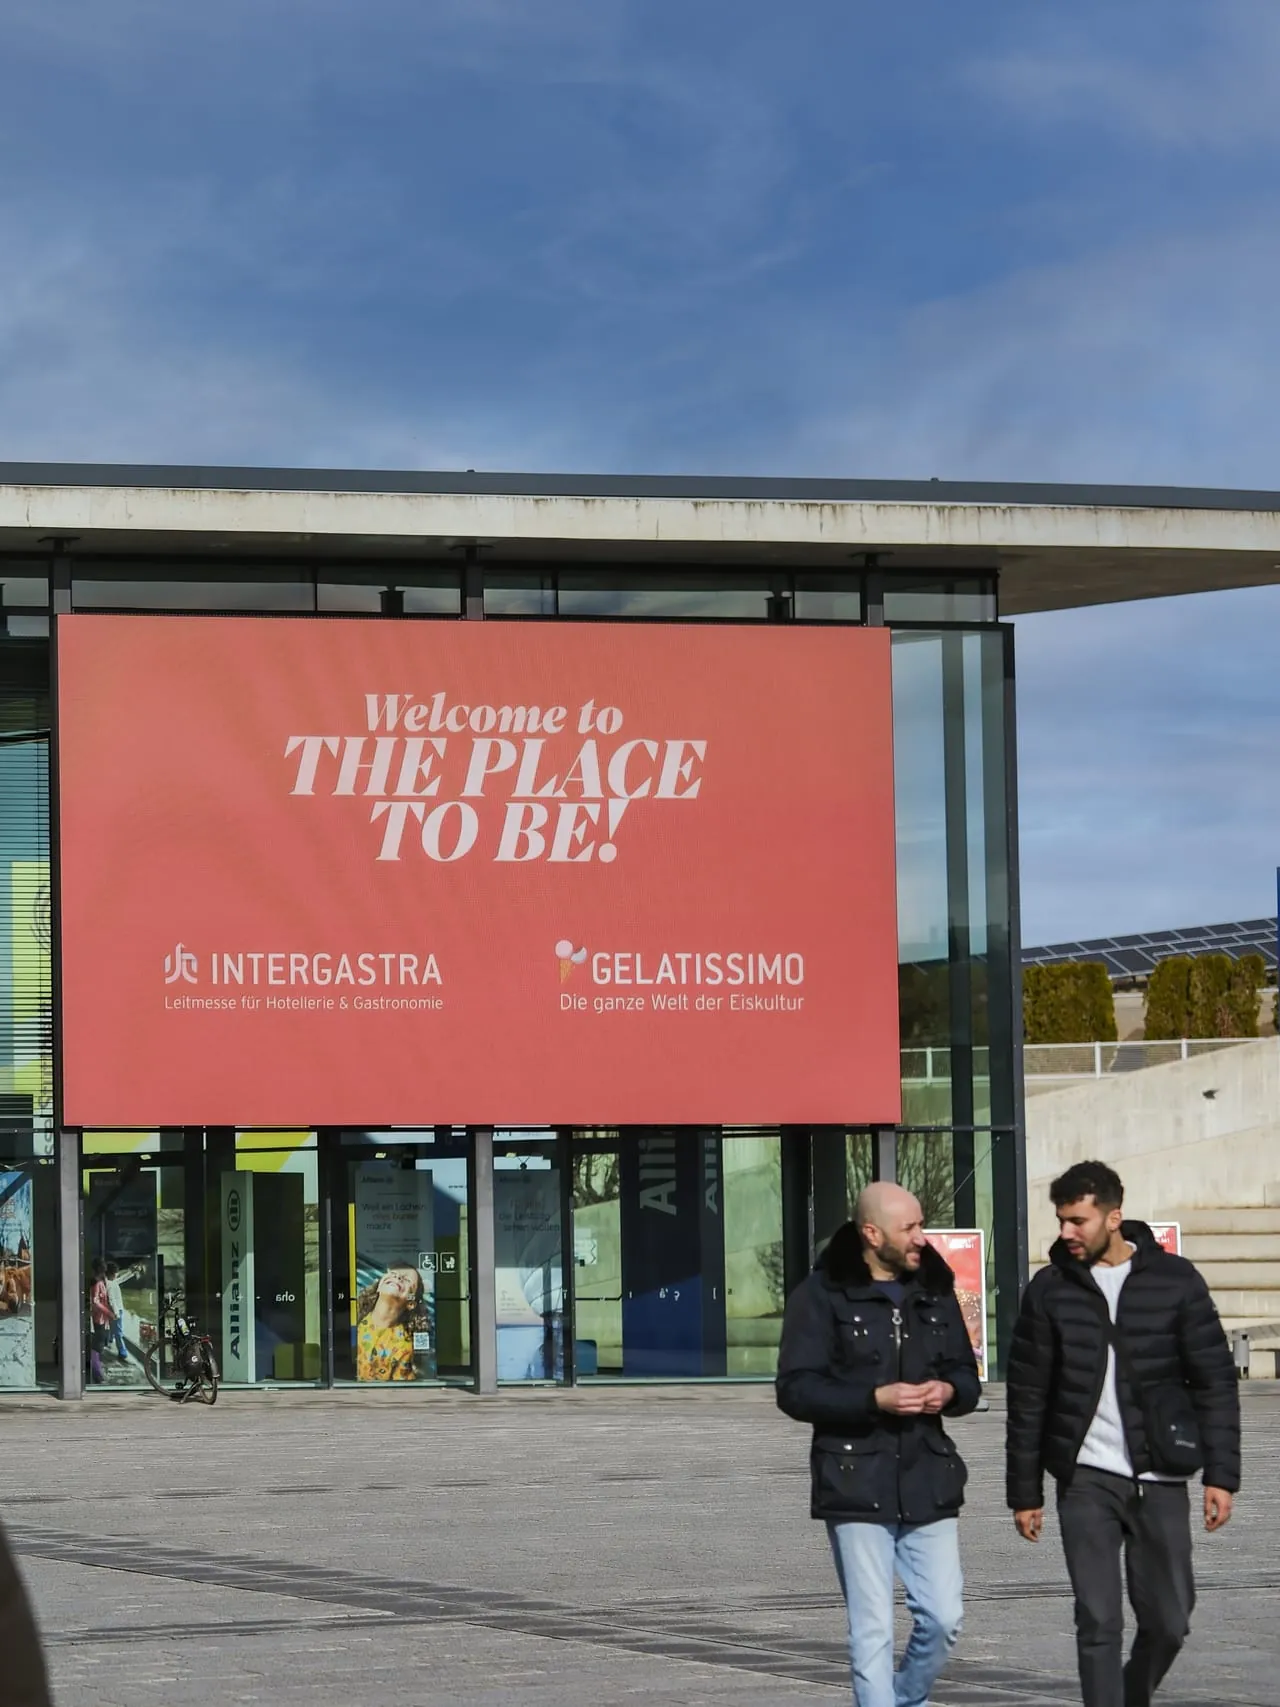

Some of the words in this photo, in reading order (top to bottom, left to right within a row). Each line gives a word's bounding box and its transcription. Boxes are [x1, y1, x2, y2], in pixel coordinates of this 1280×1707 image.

[364, 692, 567, 735] Welcome
[577, 698, 624, 735] to
[284, 736, 448, 796] THE
[460, 738, 707, 800] PLACE
[370, 801, 479, 862] TO
[493, 798, 631, 864] BE!
[211, 953, 444, 986] INTERGASTRA
[592, 952, 805, 986] GELATISSIMO
[164, 996, 237, 1010] Leitmesse
[241, 995, 261, 1010] für
[266, 996, 335, 1010] Hotellerie
[339, 996, 349, 1010] &
[353, 996, 444, 1010] Gastronomie
[560, 993, 588, 1011] Die
[593, 997, 645, 1014] ganze
[651, 993, 689, 1011] Welt
[695, 993, 723, 1011] der
[730, 993, 805, 1011] Eiskultur
[230, 1241, 241, 1361] Allianz
